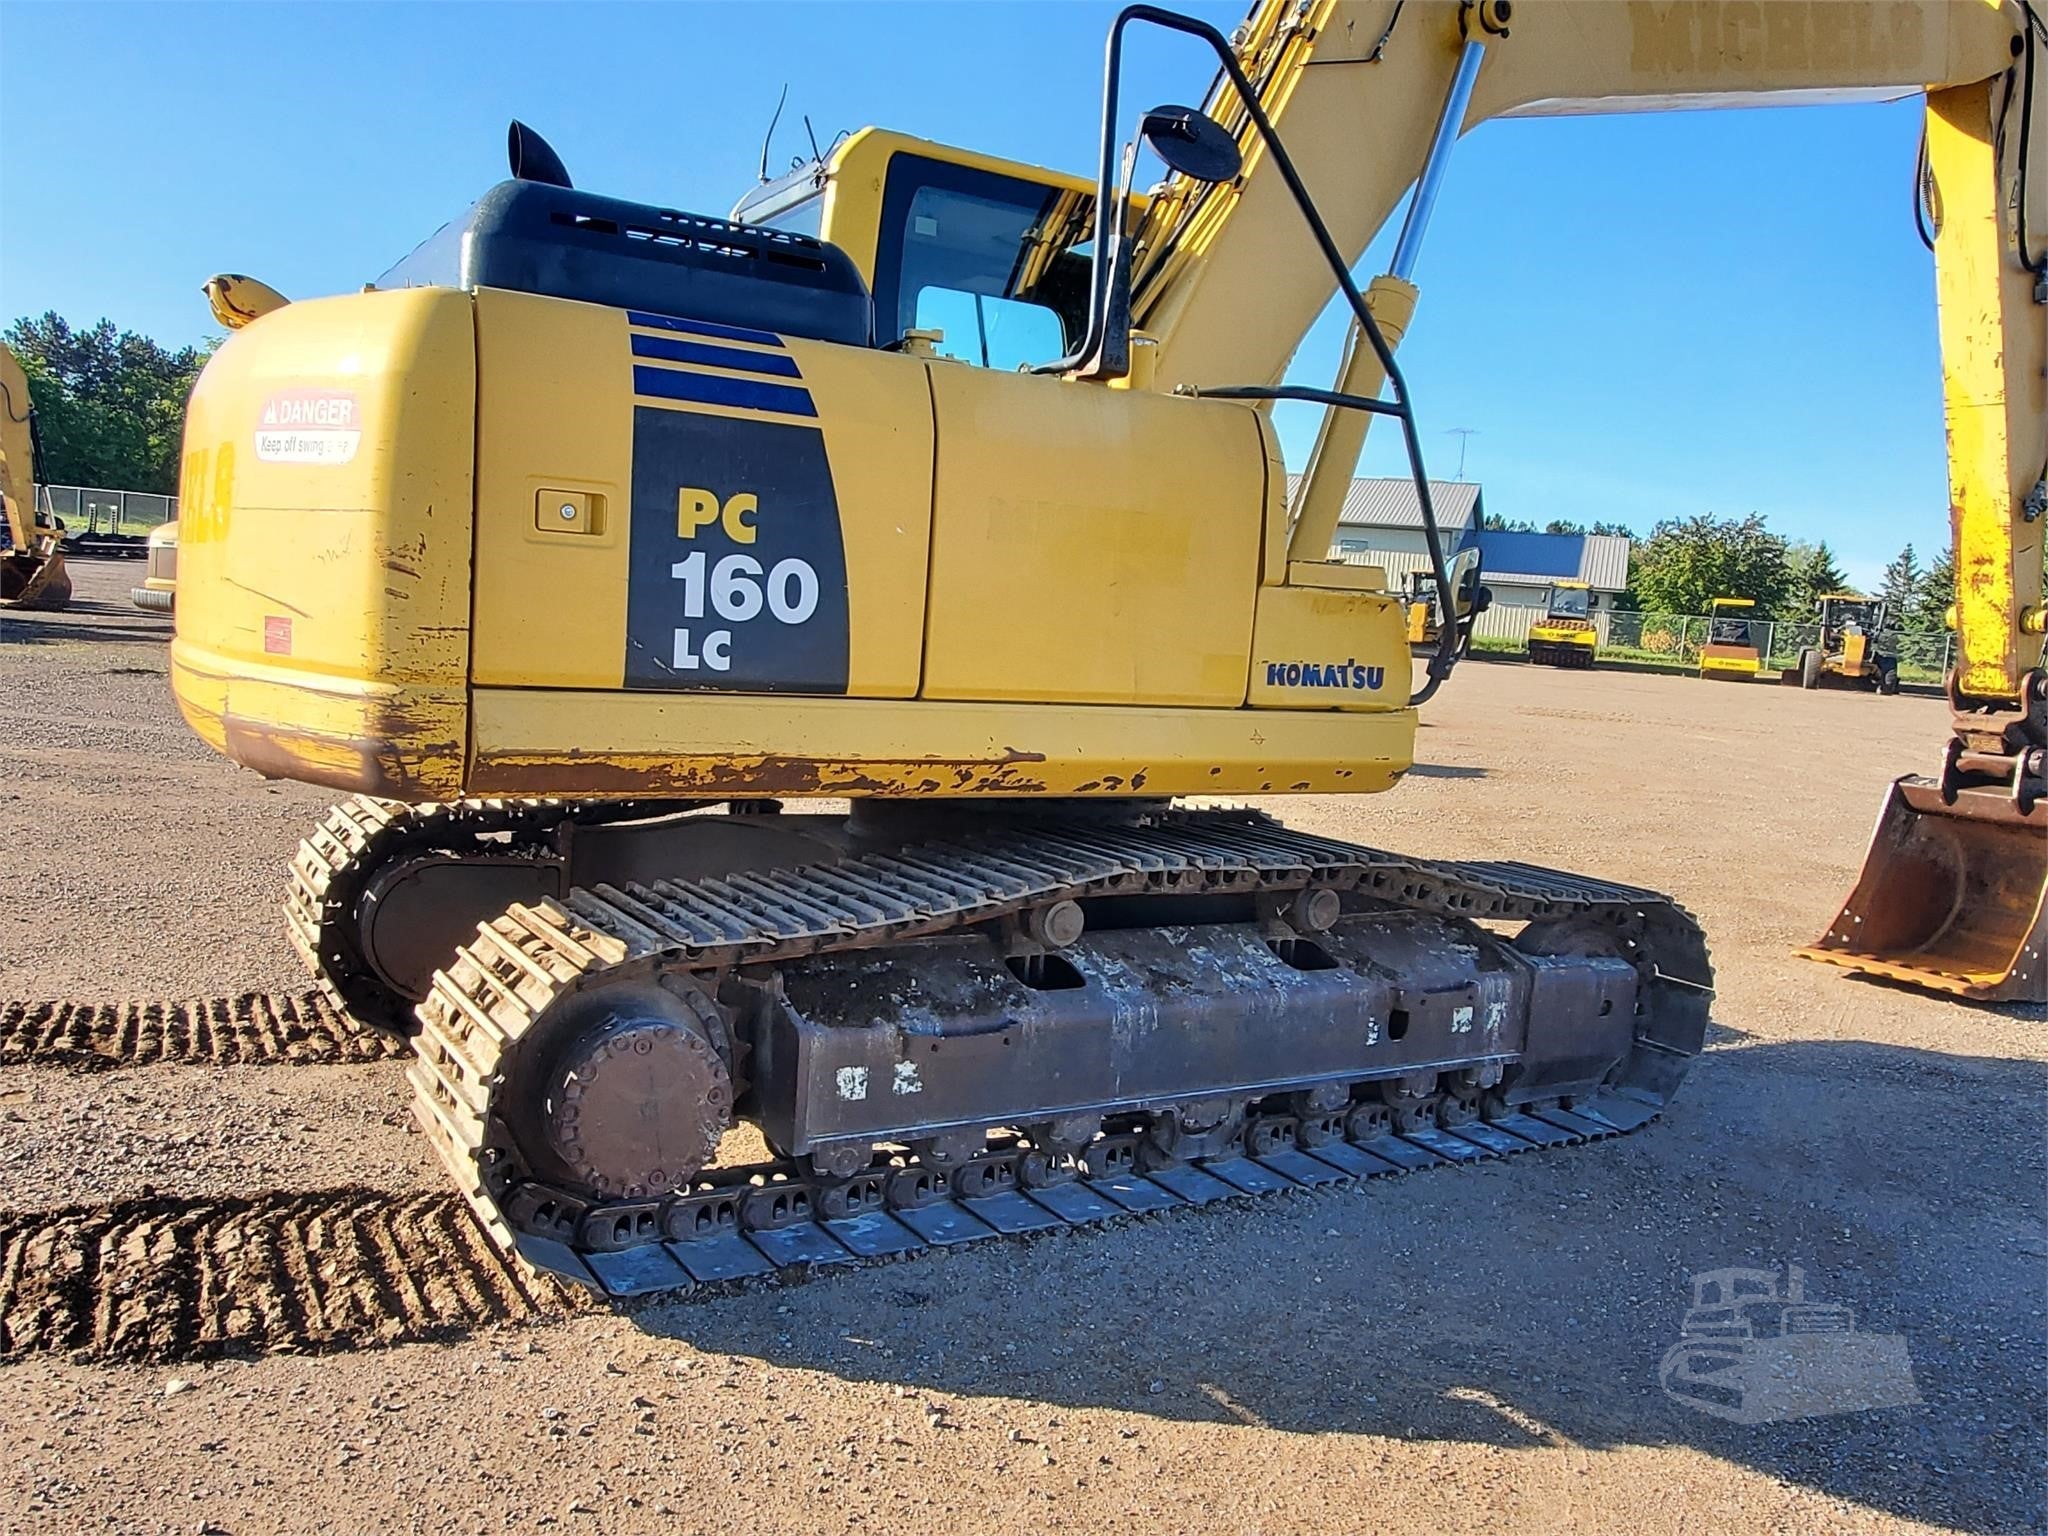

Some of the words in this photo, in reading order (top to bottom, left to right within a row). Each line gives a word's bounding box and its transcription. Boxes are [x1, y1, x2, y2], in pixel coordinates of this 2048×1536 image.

[280, 398, 352, 426] DANGER
[261, 435, 282, 455] Keep
[284, 435, 297, 453] off
[677, 486, 758, 545] PC
[671, 551, 820, 625] 160
[673, 628, 732, 671] LC
[1267, 658, 1385, 690] KOMATSU
